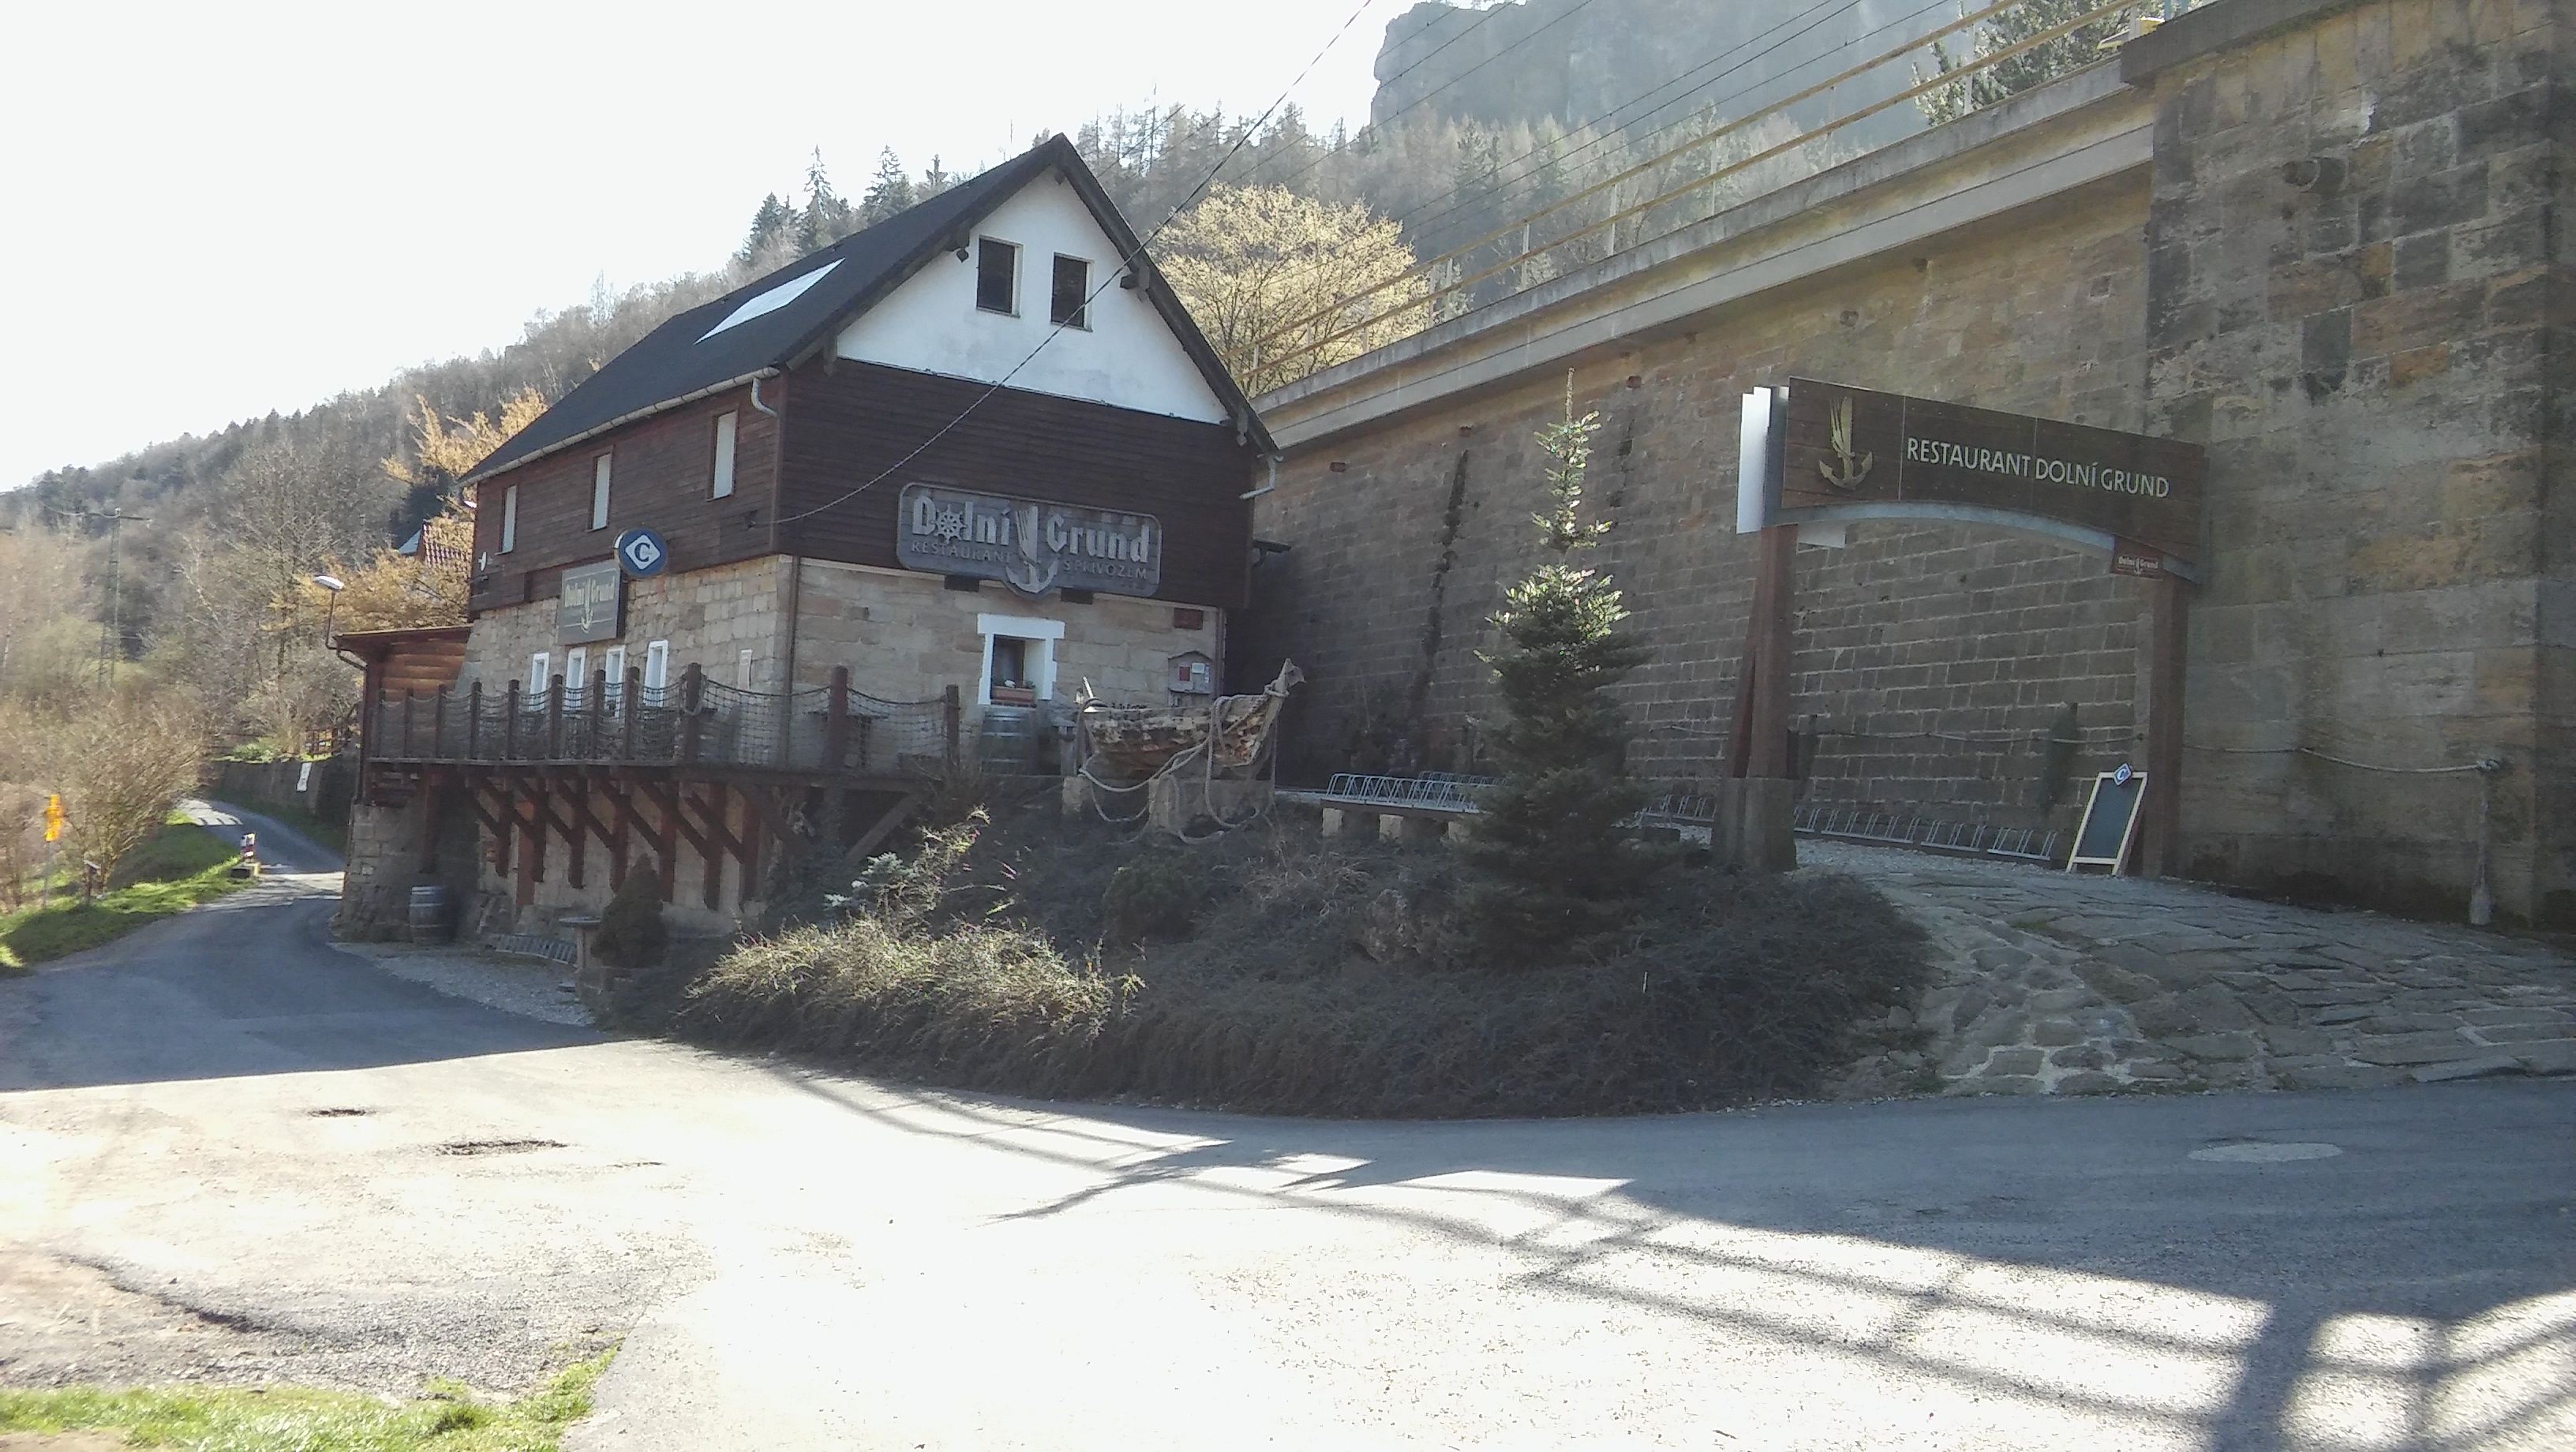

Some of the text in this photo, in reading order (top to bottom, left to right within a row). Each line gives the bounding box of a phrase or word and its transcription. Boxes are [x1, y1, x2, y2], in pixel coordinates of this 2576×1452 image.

[1907, 437, 2170, 498] RESTAURANT DOLNÍ GRUND
[911, 541, 1011, 563] RESTAURANT
[1046, 512, 1149, 563] Grund
